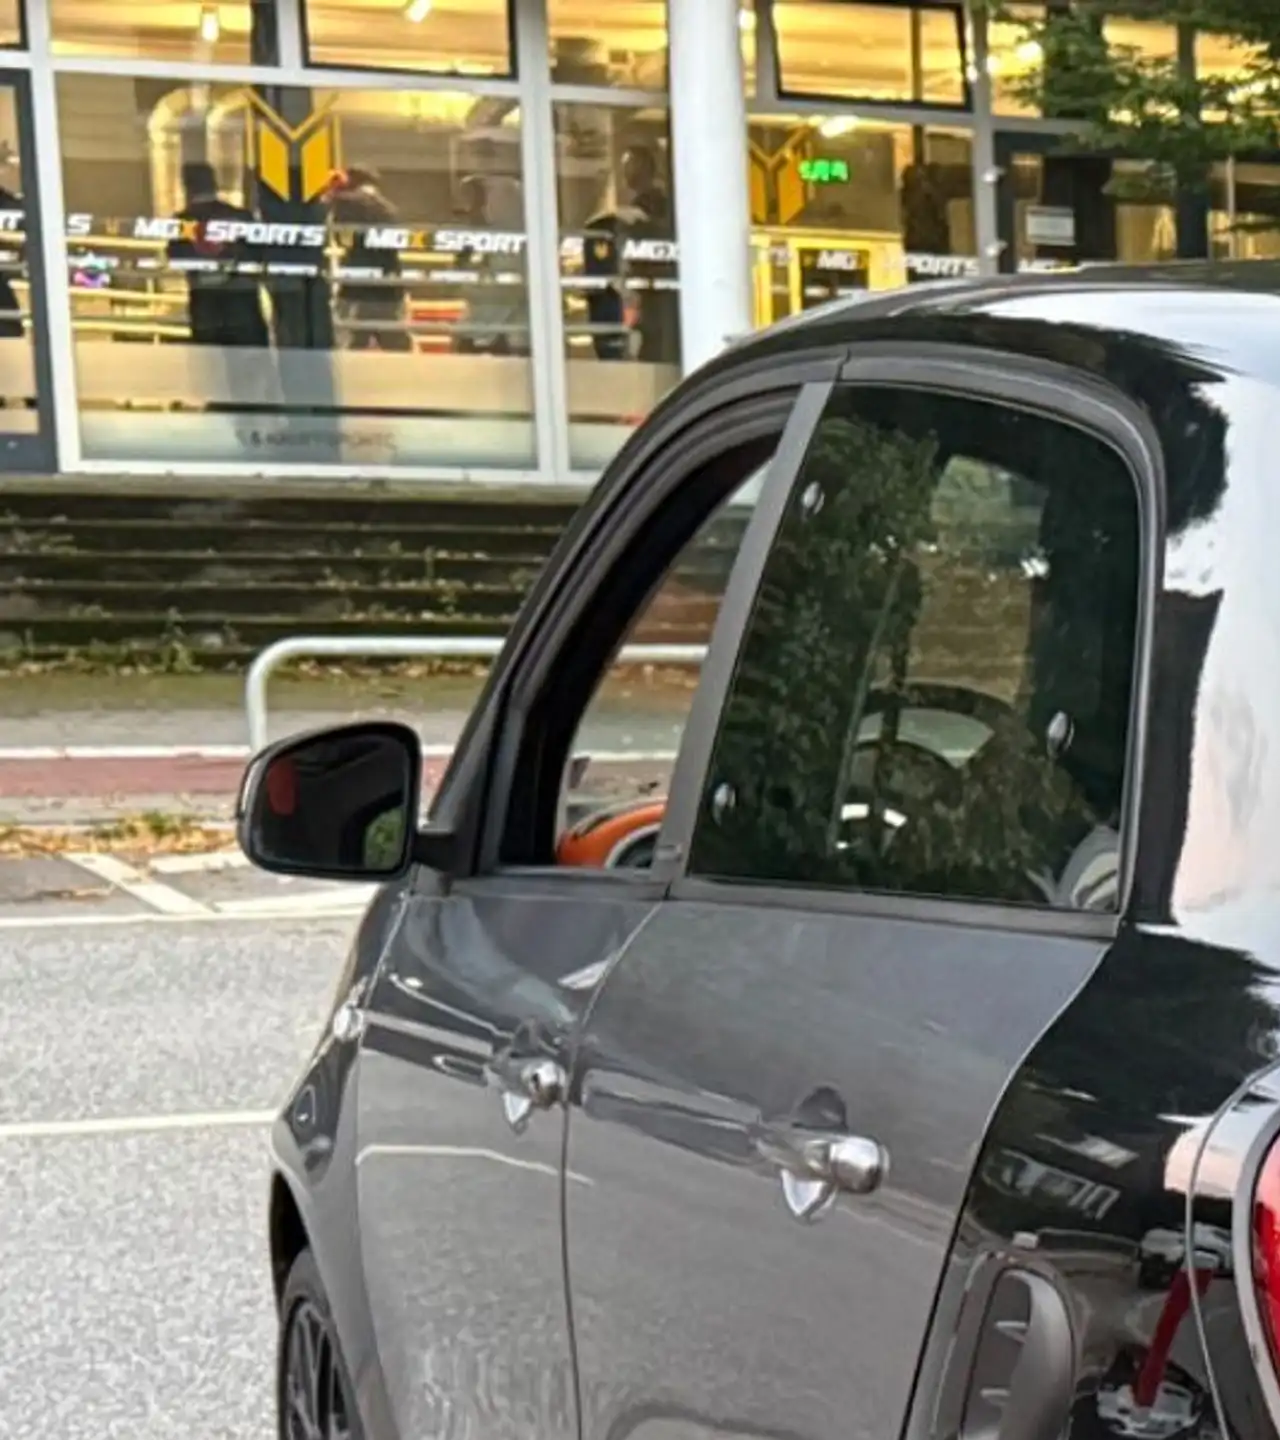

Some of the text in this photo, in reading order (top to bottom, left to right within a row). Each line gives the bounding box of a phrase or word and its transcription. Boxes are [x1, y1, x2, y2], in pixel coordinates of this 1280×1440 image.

[134, 216, 199, 240] MGX
[205, 220, 326, 246] SPORTS
[365, 228, 426, 250] MGX
